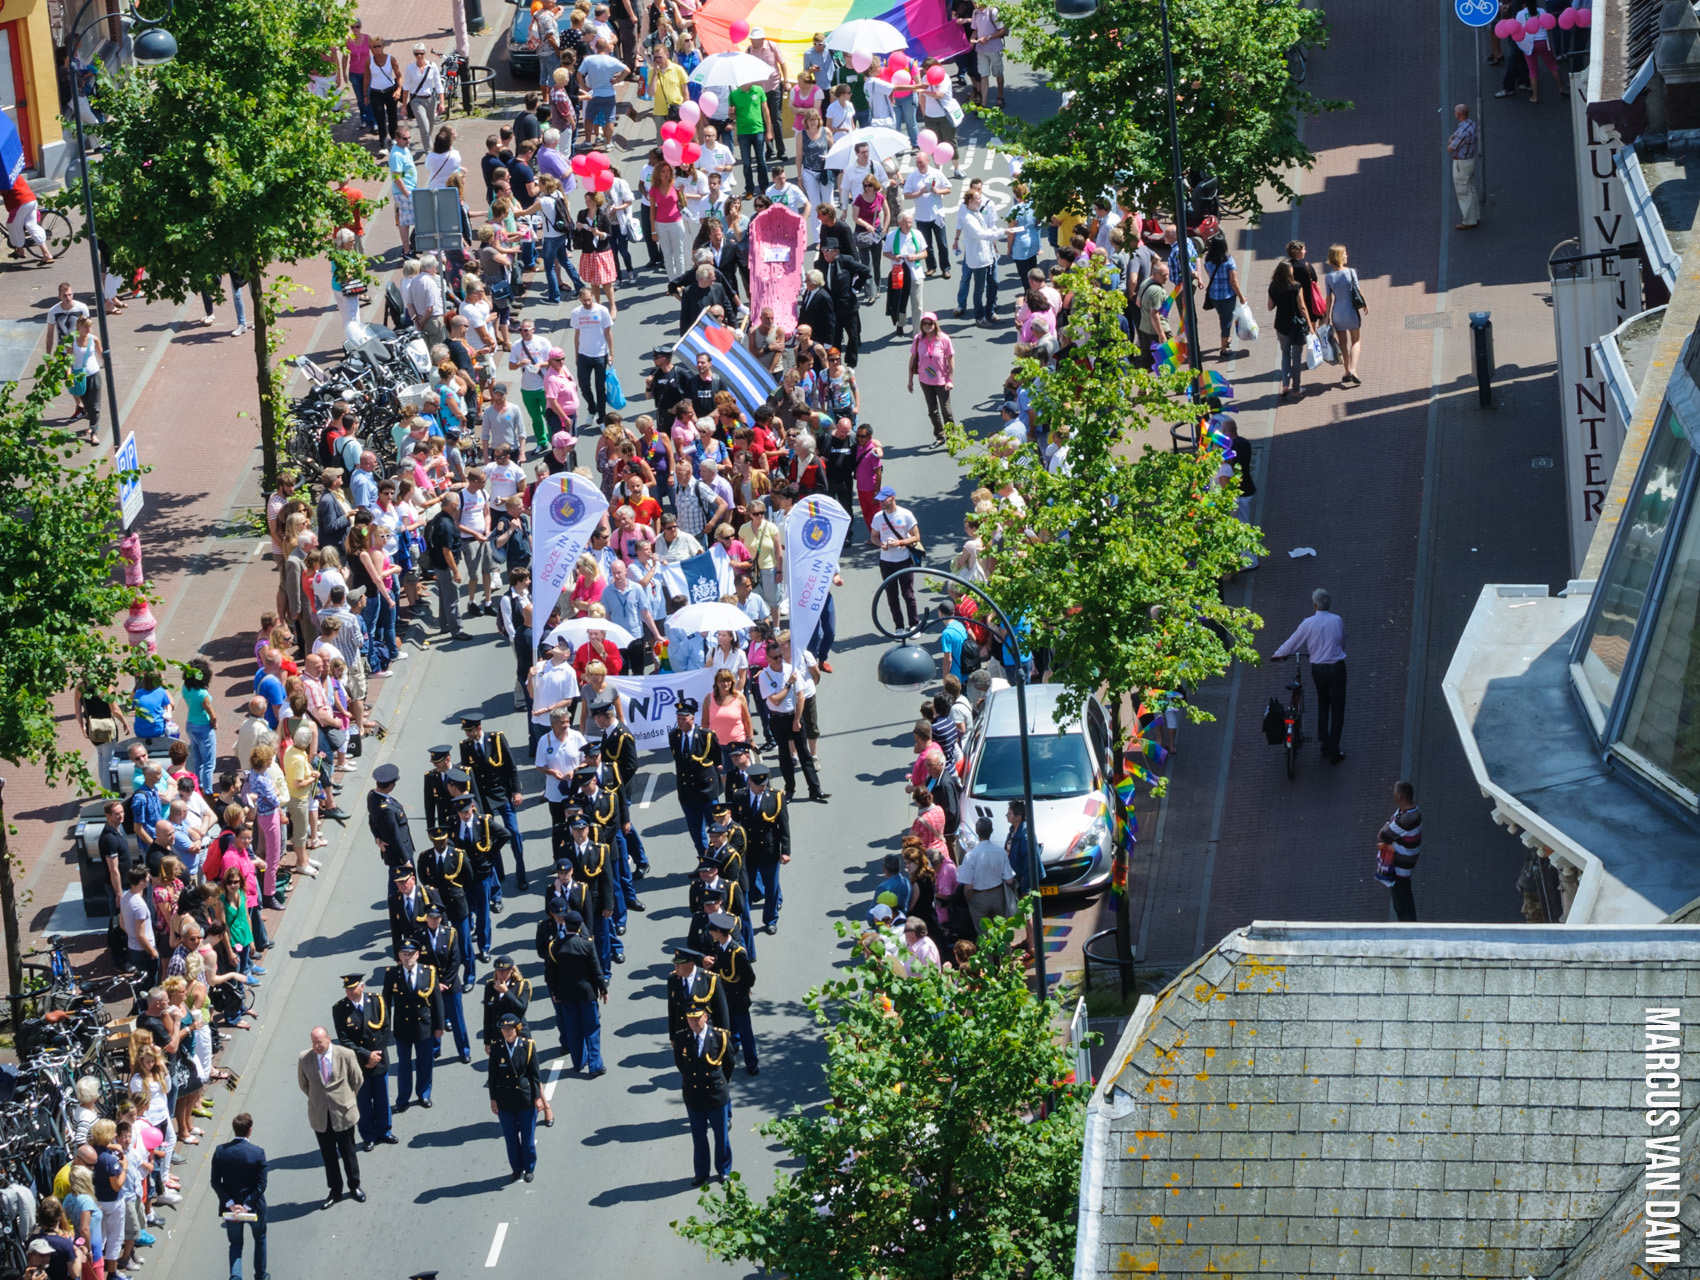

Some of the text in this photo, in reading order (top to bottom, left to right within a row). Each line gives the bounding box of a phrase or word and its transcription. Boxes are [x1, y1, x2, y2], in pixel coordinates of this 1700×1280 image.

[541, 550, 561, 582] ROZE
[556, 534, 570, 550] IN
[552, 540, 581, 588] BLAUW
[797, 574, 817, 608] ROZE
[811, 559, 823, 573] IN
[810, 562, 834, 612] BLAUW
